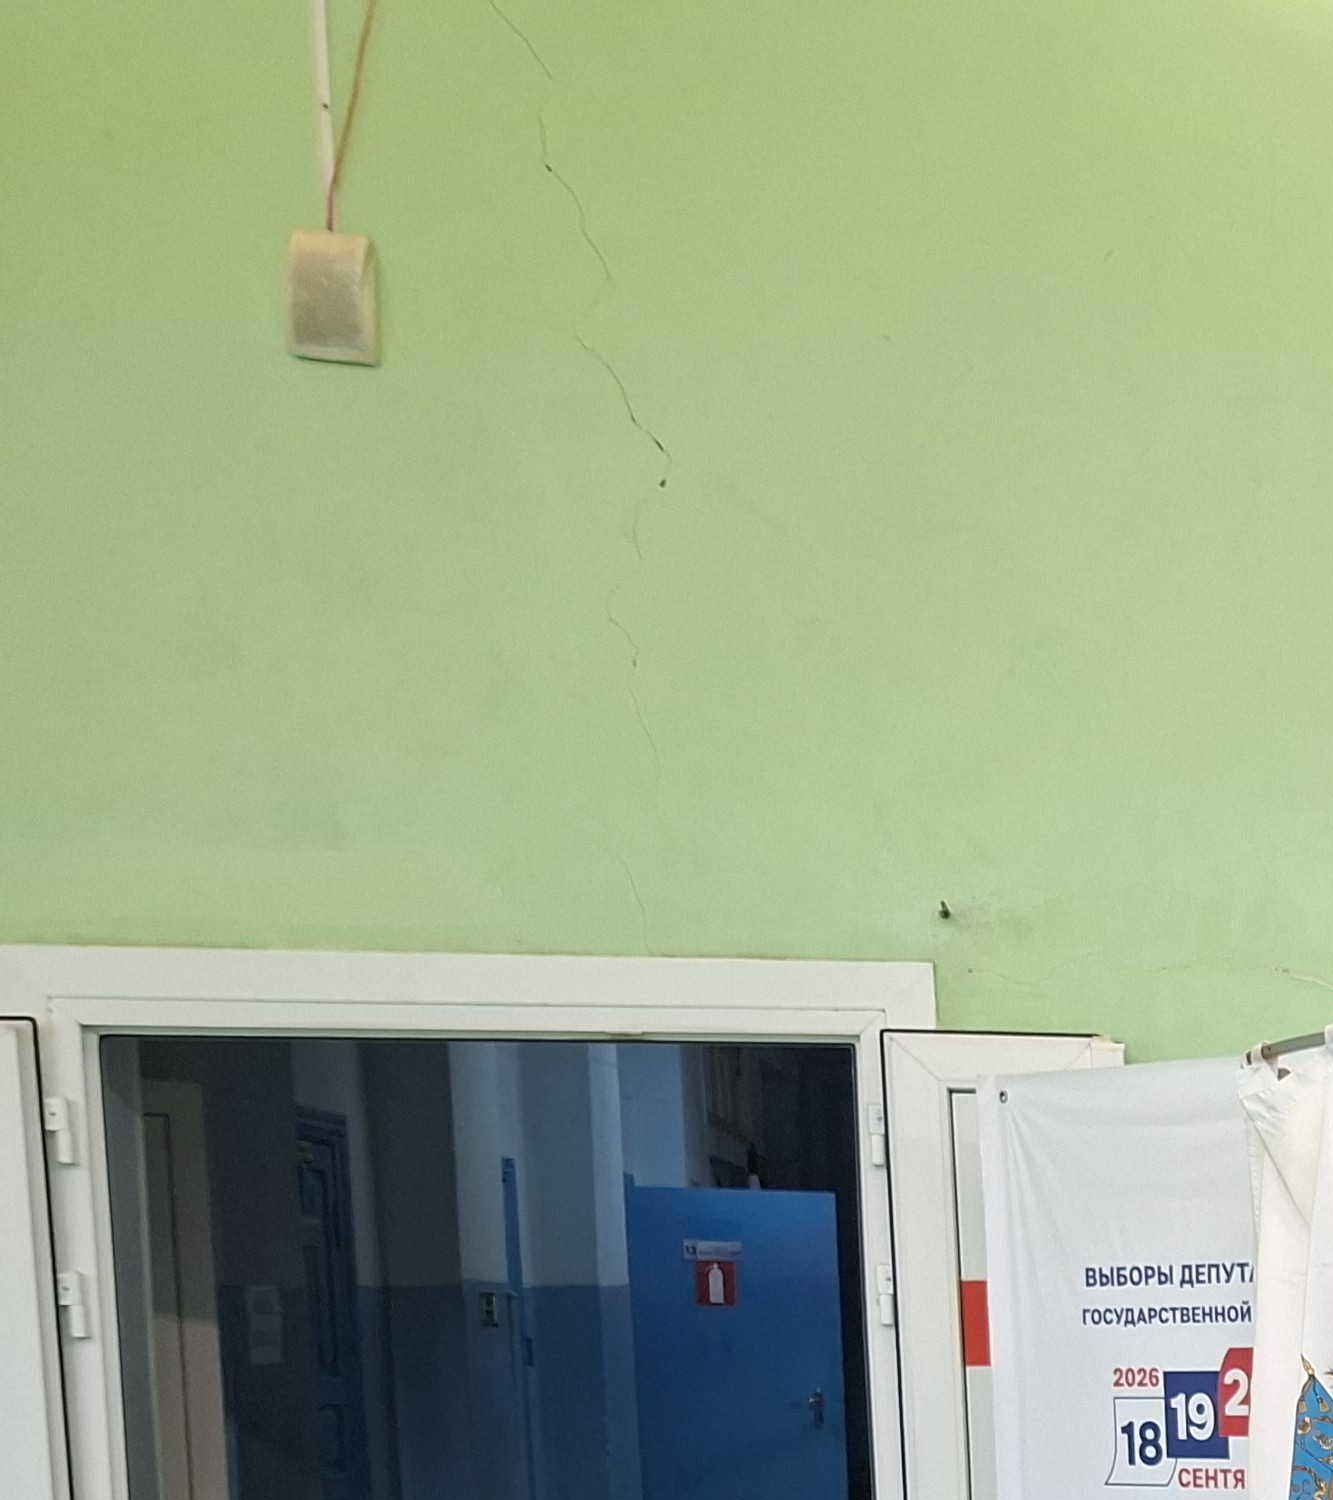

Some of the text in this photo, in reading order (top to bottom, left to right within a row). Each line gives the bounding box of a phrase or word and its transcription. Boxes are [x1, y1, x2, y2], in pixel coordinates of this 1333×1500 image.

[1085, 1265, 1174, 1287] ВЫБОРЫ
[1082, 1300, 1252, 1327] ГОСУДАРСТВЕННОЙ
[1113, 1368, 1159, 1387] 2026
[1121, 1421, 1163, 1466] 18
[1171, 1393, 1215, 1441] 19
[1178, 1469, 1246, 1489] СЕНТЯ
